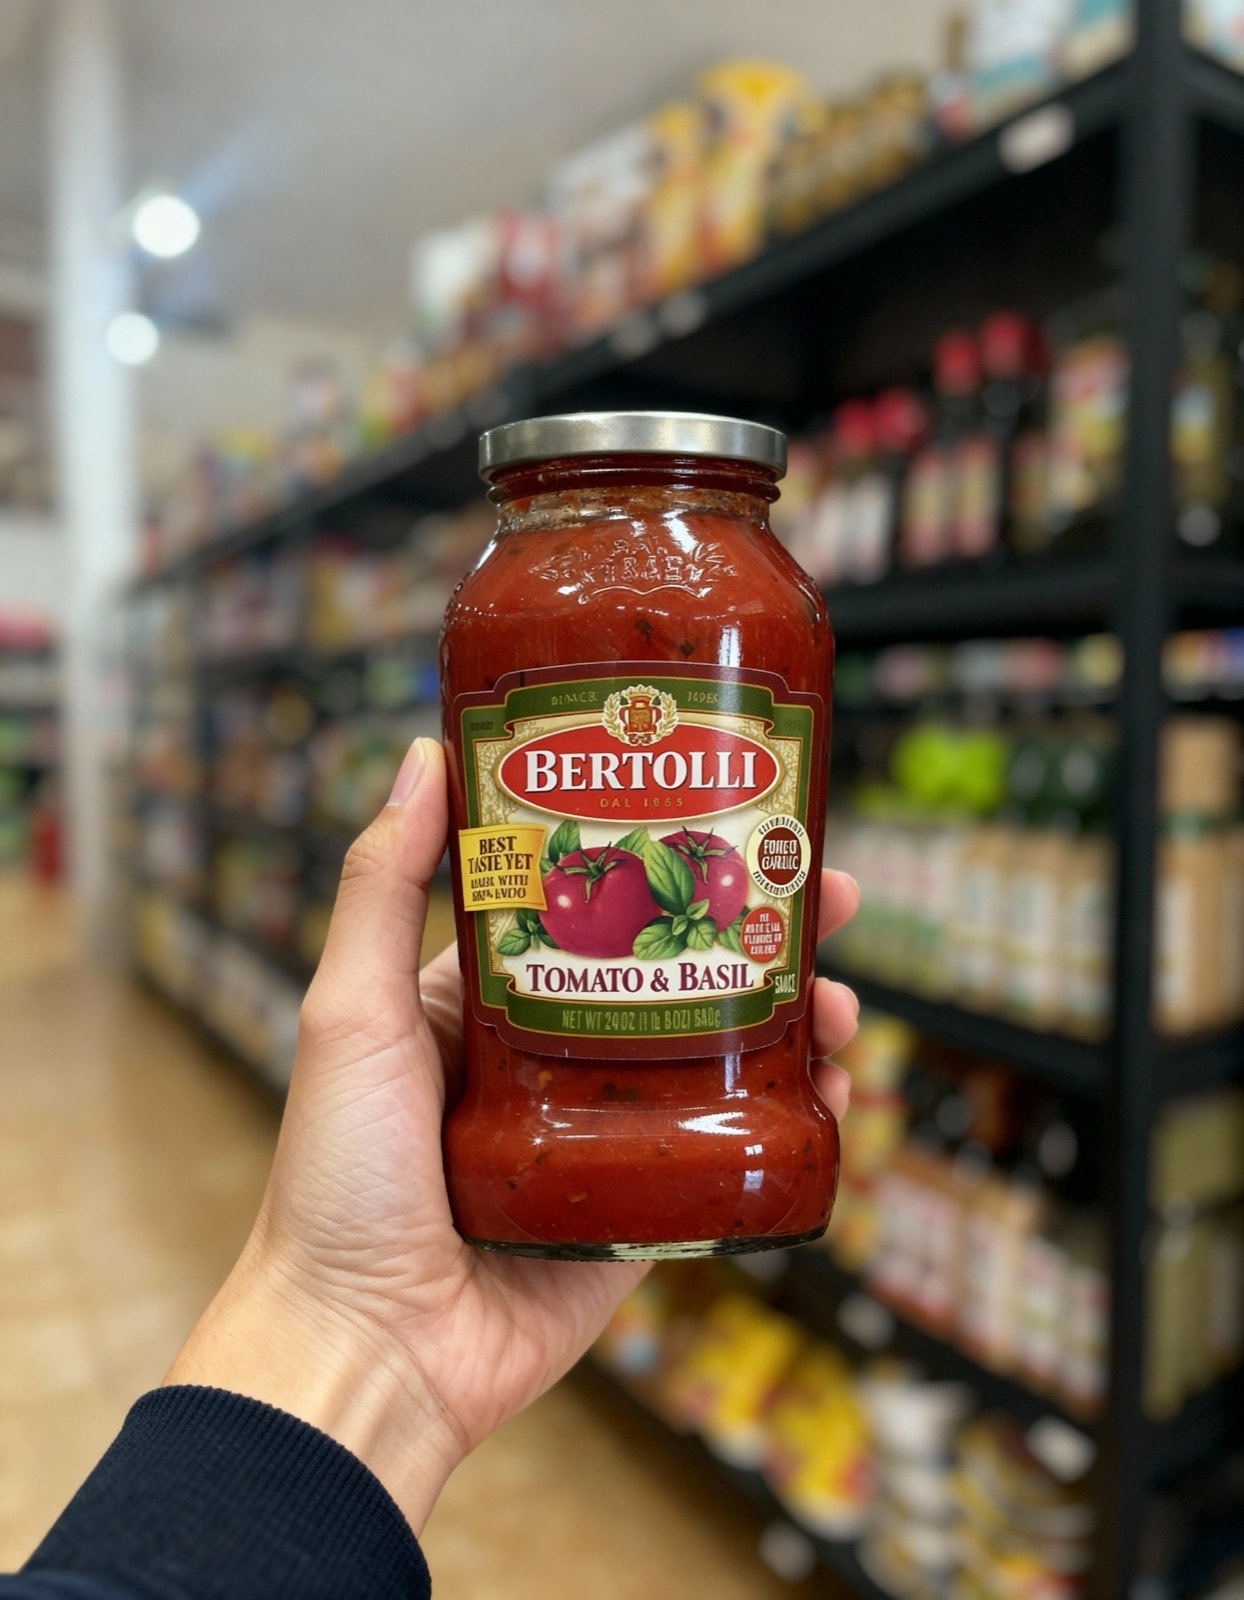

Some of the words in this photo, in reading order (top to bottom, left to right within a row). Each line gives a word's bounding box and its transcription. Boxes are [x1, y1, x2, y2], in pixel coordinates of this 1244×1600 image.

[524, 749, 758, 793] BERTOLLI
[599, 798, 632, 809] DAL
[479, 835, 518, 855] BEST
[467, 854, 503, 875] TASTE
[503, 853, 534, 871] YET
[526, 964, 645, 993] TOMATO
[650, 967, 670, 993] &
[678, 962, 754, 992] BASIL
[561, 1009, 583, 1030] NET
[585, 1010, 603, 1031] WT
